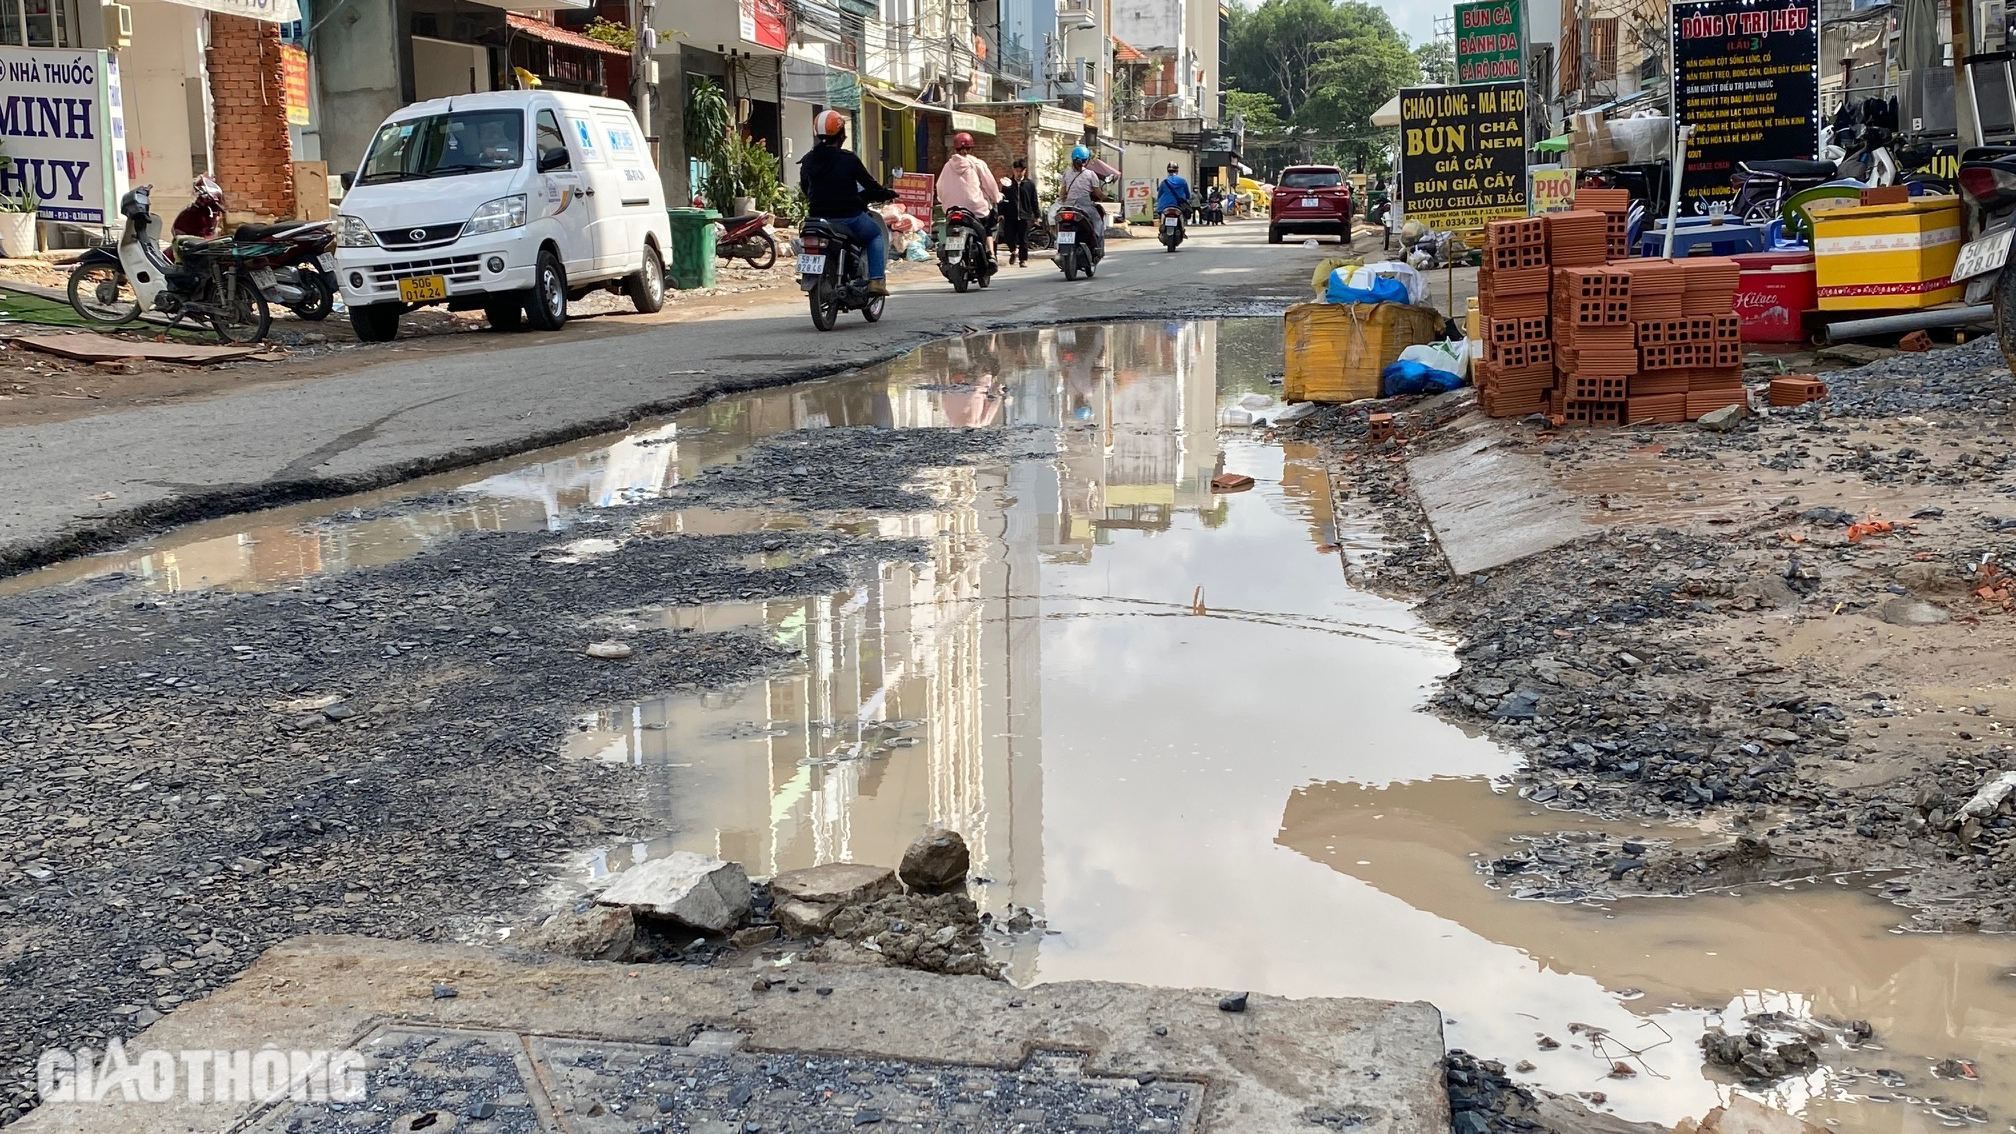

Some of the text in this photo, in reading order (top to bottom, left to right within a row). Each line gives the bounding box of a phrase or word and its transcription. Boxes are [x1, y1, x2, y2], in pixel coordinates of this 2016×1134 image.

[1463, 2, 1512, 28] BÚN CÁ
[1682, 3, 1808, 39] ĐÔNG Y TRỊ LIỆU
[1459, 32, 1518, 55] BÁNH ĐA
[10, 56, 94, 84] NHÀ THUỐC
[1461, 58, 1475, 81] CÁ
[1475, 57, 1490, 80] RÔ
[1716, 55, 1728, 67] CỘT
[1729, 53, 1745, 65] SỐNG
[1732, 69, 1748, 78] BONG
[1700, 82, 1719, 93] HUYỆT
[1734, 82, 1744, 92] TRỊ
[1402, 91, 1434, 120] CHÁO
[1437, 89, 1468, 117] LÒNG
[1479, 86, 1497, 114] MÁ
[1500, 89, 1524, 112] HEO
[1700, 96, 1719, 107] HUYỆT
[0, 96, 94, 140] MINH
[1730, 108, 1742, 118] LẠC
[1406, 117, 1519, 156] BÚN CHẢ
[1480, 137, 1523, 149] NEM
[1435, 153, 1494, 173] GIẢ CẦY
[1687, 150, 1702, 159] GOUT
[1126, 186, 1150, 199] T3
[1414, 171, 1516, 194] BÚN GIẢ CẦY
[1535, 171, 1572, 198] PHỞ
[1407, 188, 1524, 211] RƯỢU CHUẨN BẮC
[1446, 218, 1466, 227] 0334
[1469, 216, 1484, 225] 291
[412, 277, 432, 289] 50G
[406, 288, 441, 301] 014.24
